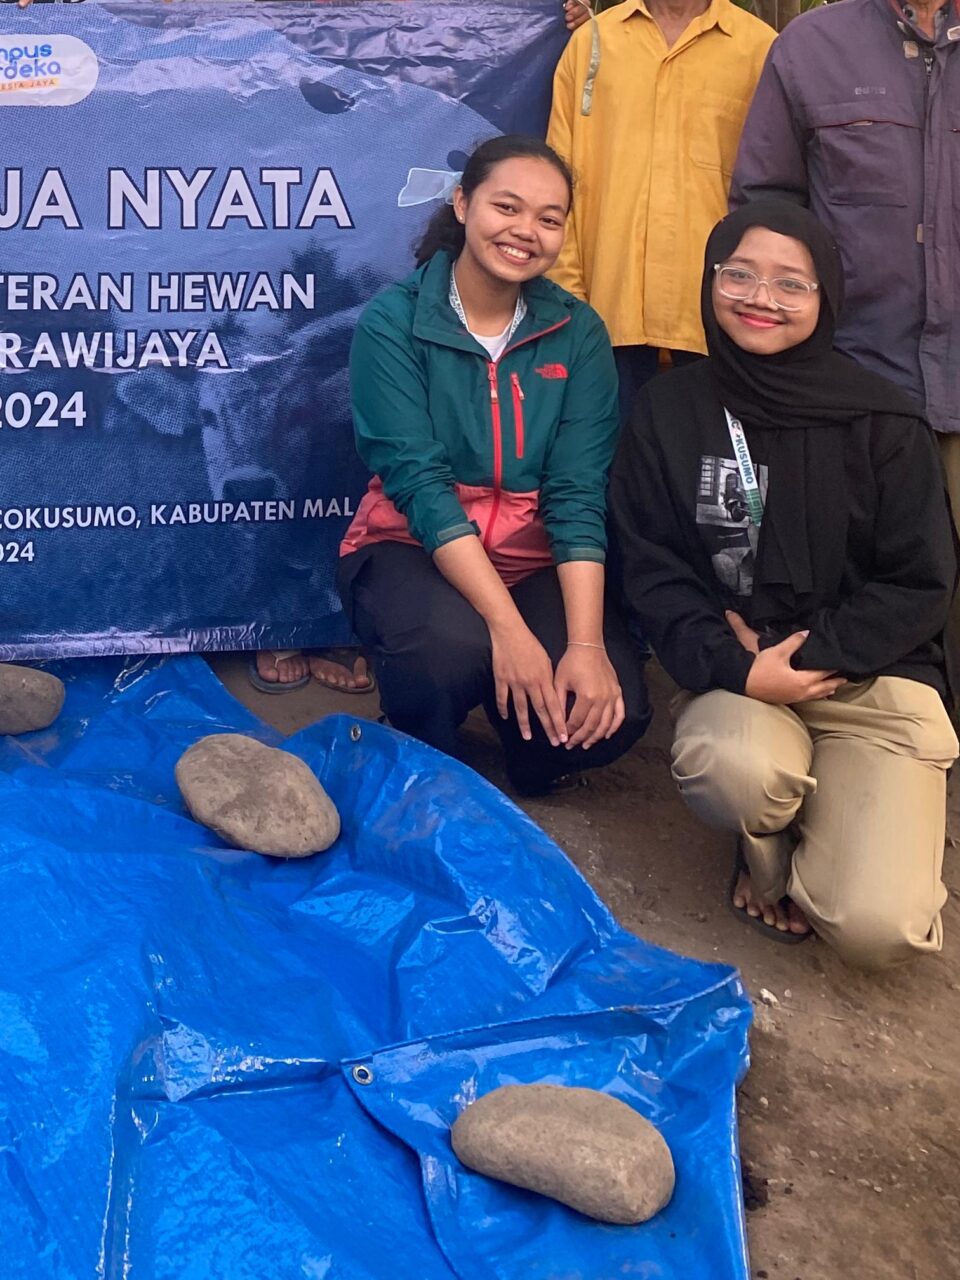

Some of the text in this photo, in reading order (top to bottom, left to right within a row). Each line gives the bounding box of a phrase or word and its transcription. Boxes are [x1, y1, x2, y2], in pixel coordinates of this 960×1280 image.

[30, 79, 55, 88] JAYA
[110, 170, 351, 226] NYATA
[151, 274, 314, 309] HEWAN
[152, 501, 294, 524] KABUPATEN
